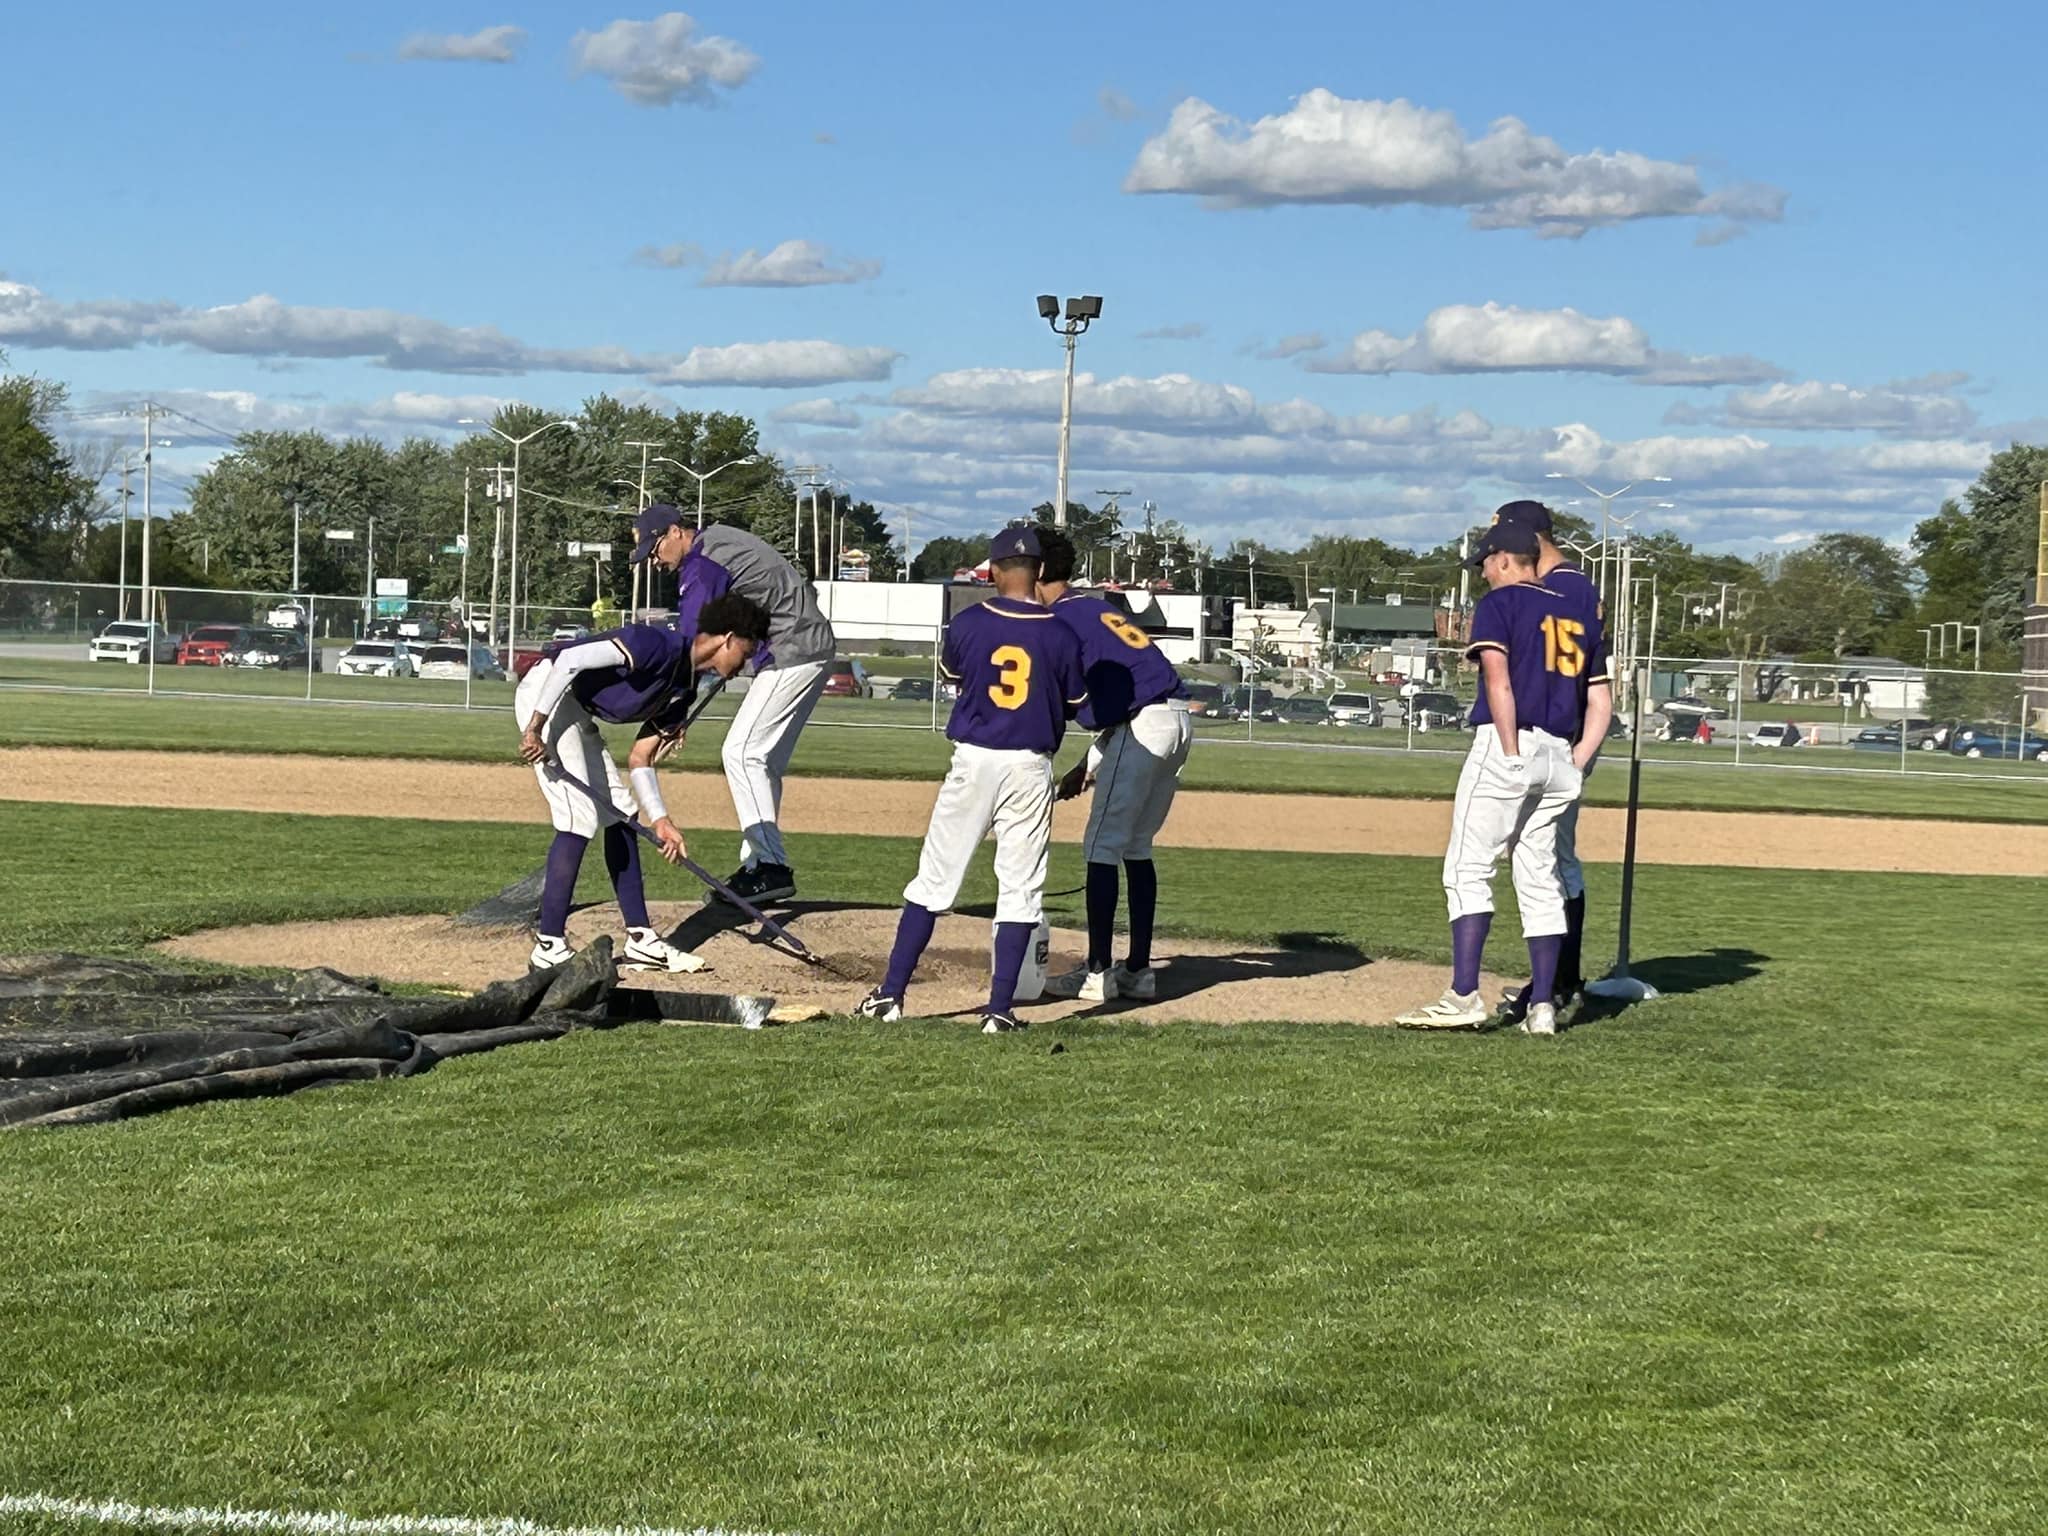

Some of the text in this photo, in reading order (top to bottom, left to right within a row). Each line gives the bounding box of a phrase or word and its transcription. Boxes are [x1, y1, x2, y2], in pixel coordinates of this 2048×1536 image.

[1100, 612, 1150, 649] 6
[1540, 614, 1585, 678] 15
[988, 645, 1032, 710] 3
